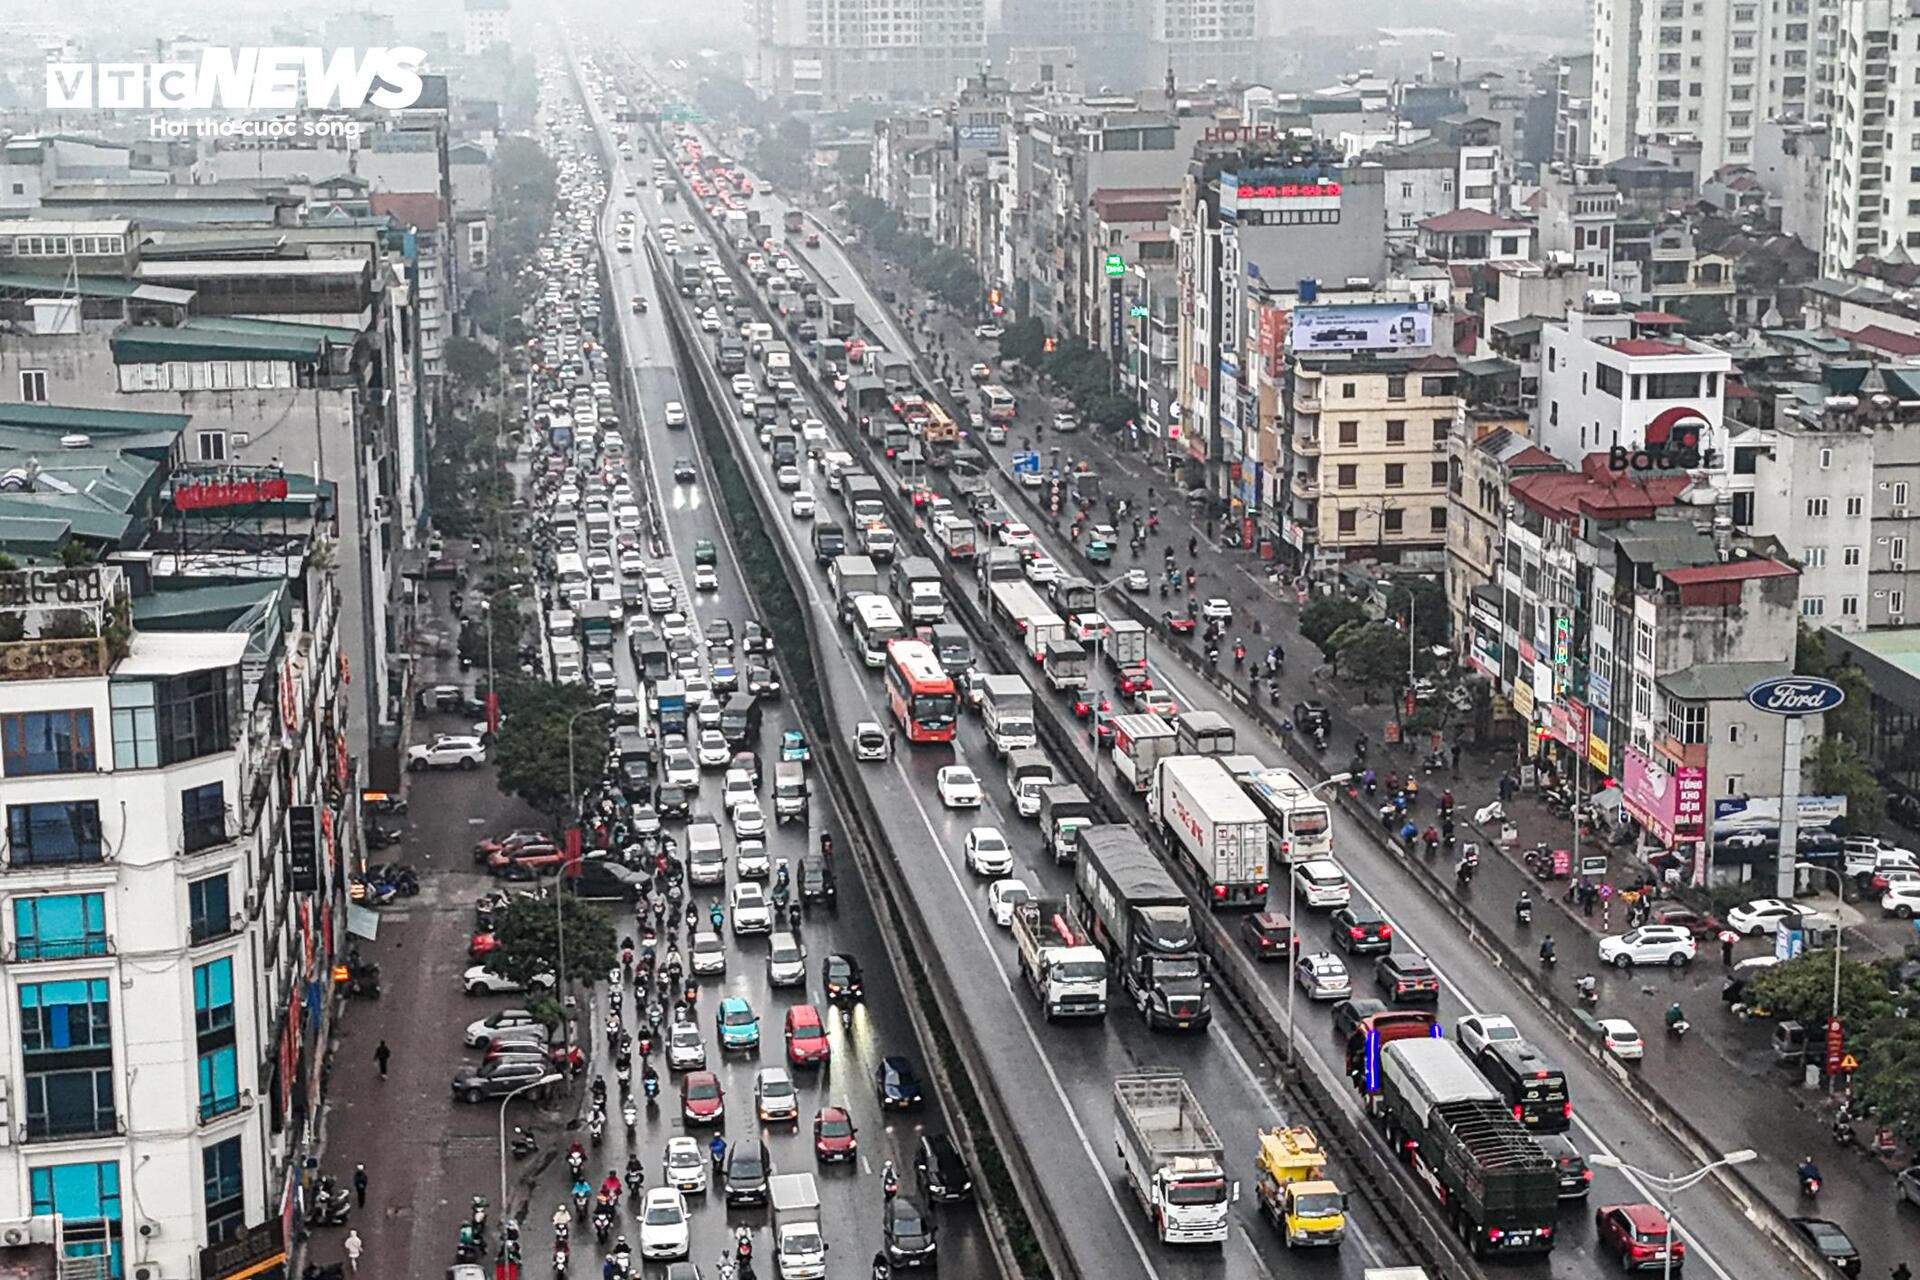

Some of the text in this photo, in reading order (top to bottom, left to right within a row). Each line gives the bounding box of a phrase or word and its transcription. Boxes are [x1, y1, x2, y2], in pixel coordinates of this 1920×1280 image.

[1205, 126, 1279, 144] HOTEL
[1182, 240, 1194, 316] HOTEL
[1767, 684, 1826, 708] Ford
